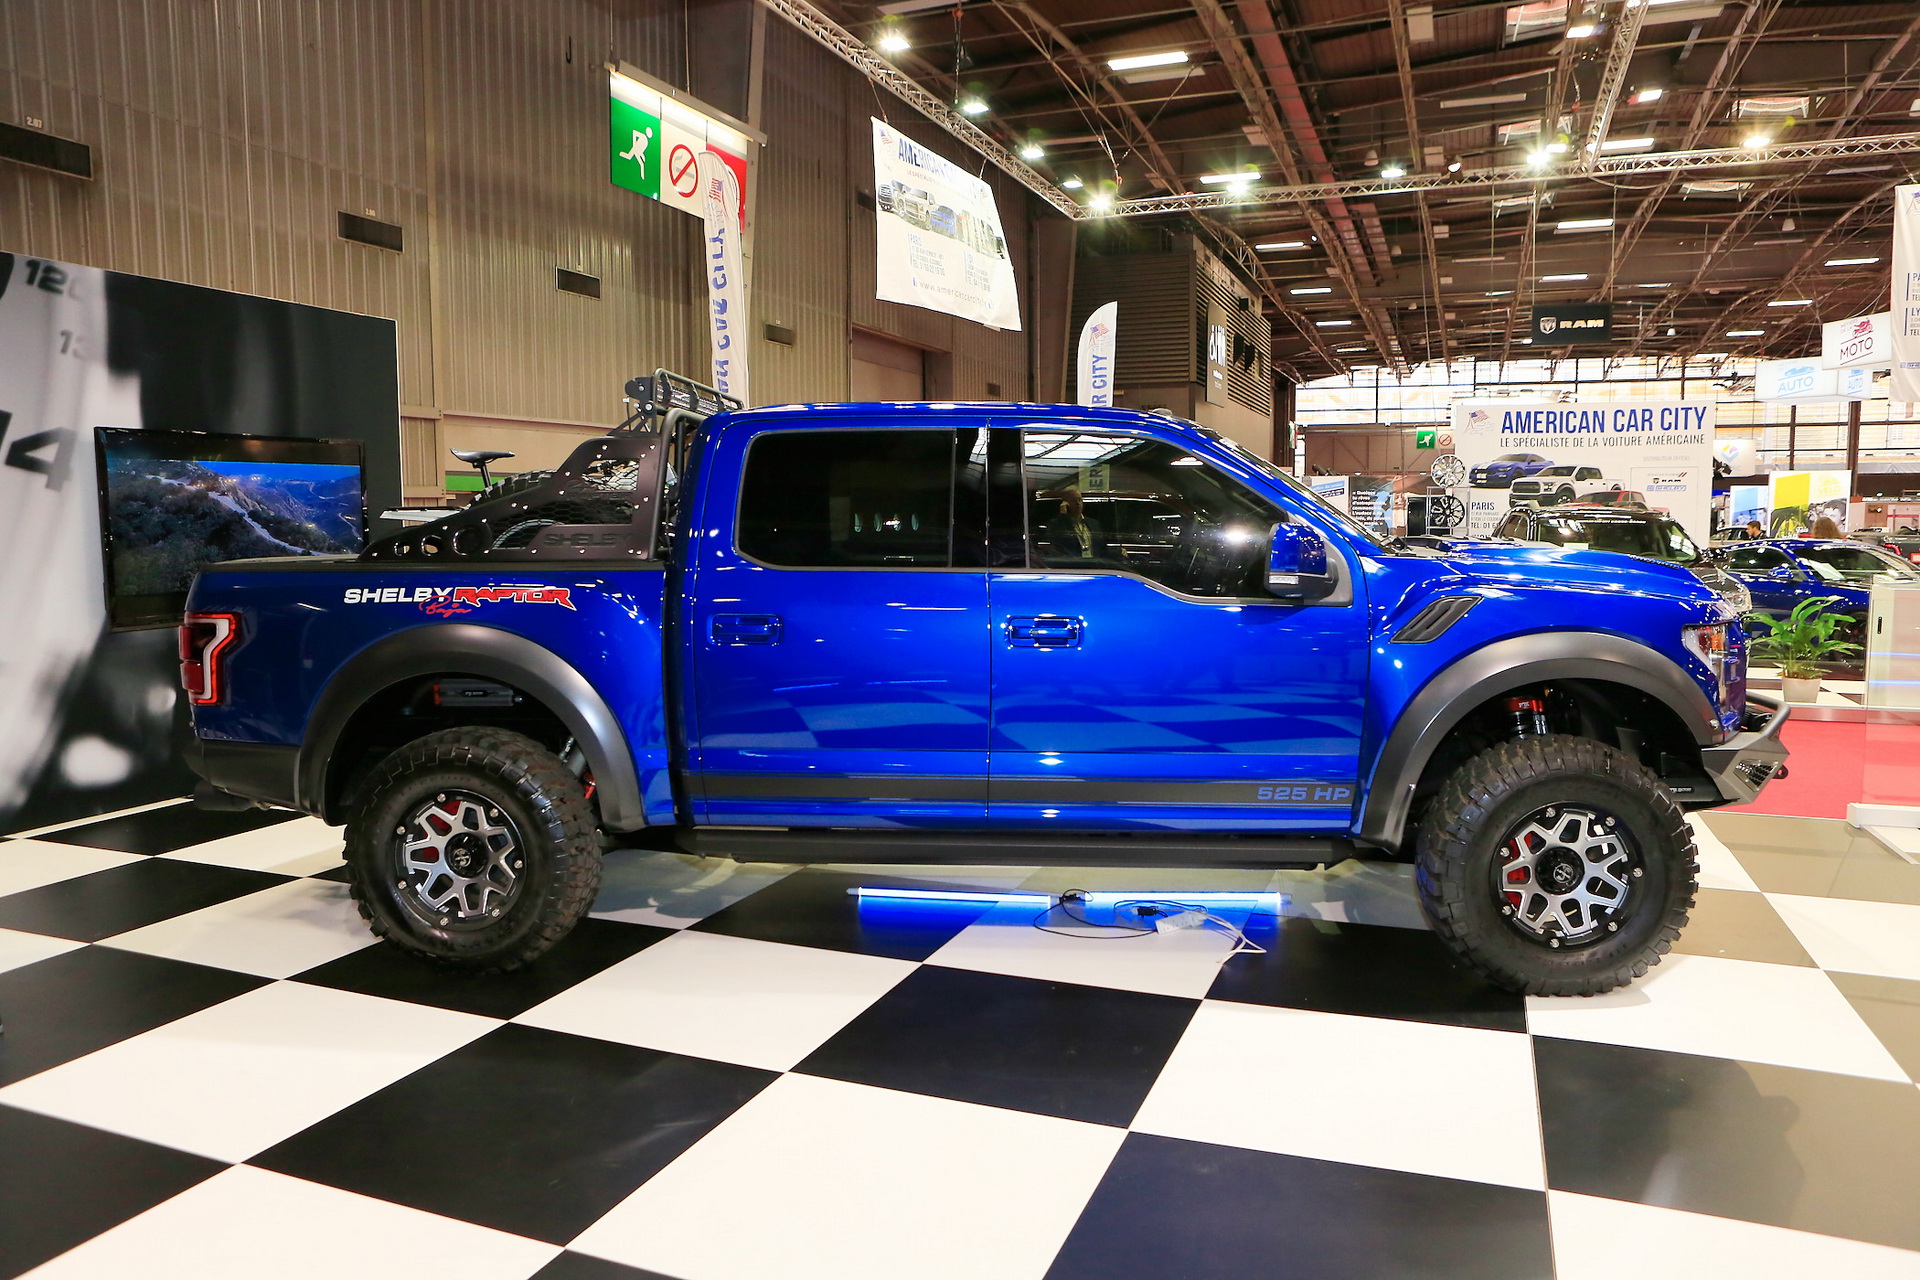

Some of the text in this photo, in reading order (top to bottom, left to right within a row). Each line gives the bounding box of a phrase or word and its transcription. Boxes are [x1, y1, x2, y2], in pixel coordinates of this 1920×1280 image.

[1559, 319, 1604, 329] RAM
[1839, 336, 1873, 361] MOTO
[1092, 354, 1107, 390] CITY
[1777, 376, 1814, 393] AUTO
[1848, 376, 1864, 390] AUTO
[1501, 406, 1707, 434] AMERICAN CAR CITY
[1500, 432, 1705, 448] LE SPÉCIALISTE DE LA VOITURE AMÉRICAINE
[1471, 502, 1495, 511] PARIS
[344, 586, 577, 611] SHELBY RAPTOR
[418, 595, 472, 617] Baja
[1257, 786, 1351, 801] 525 HP
